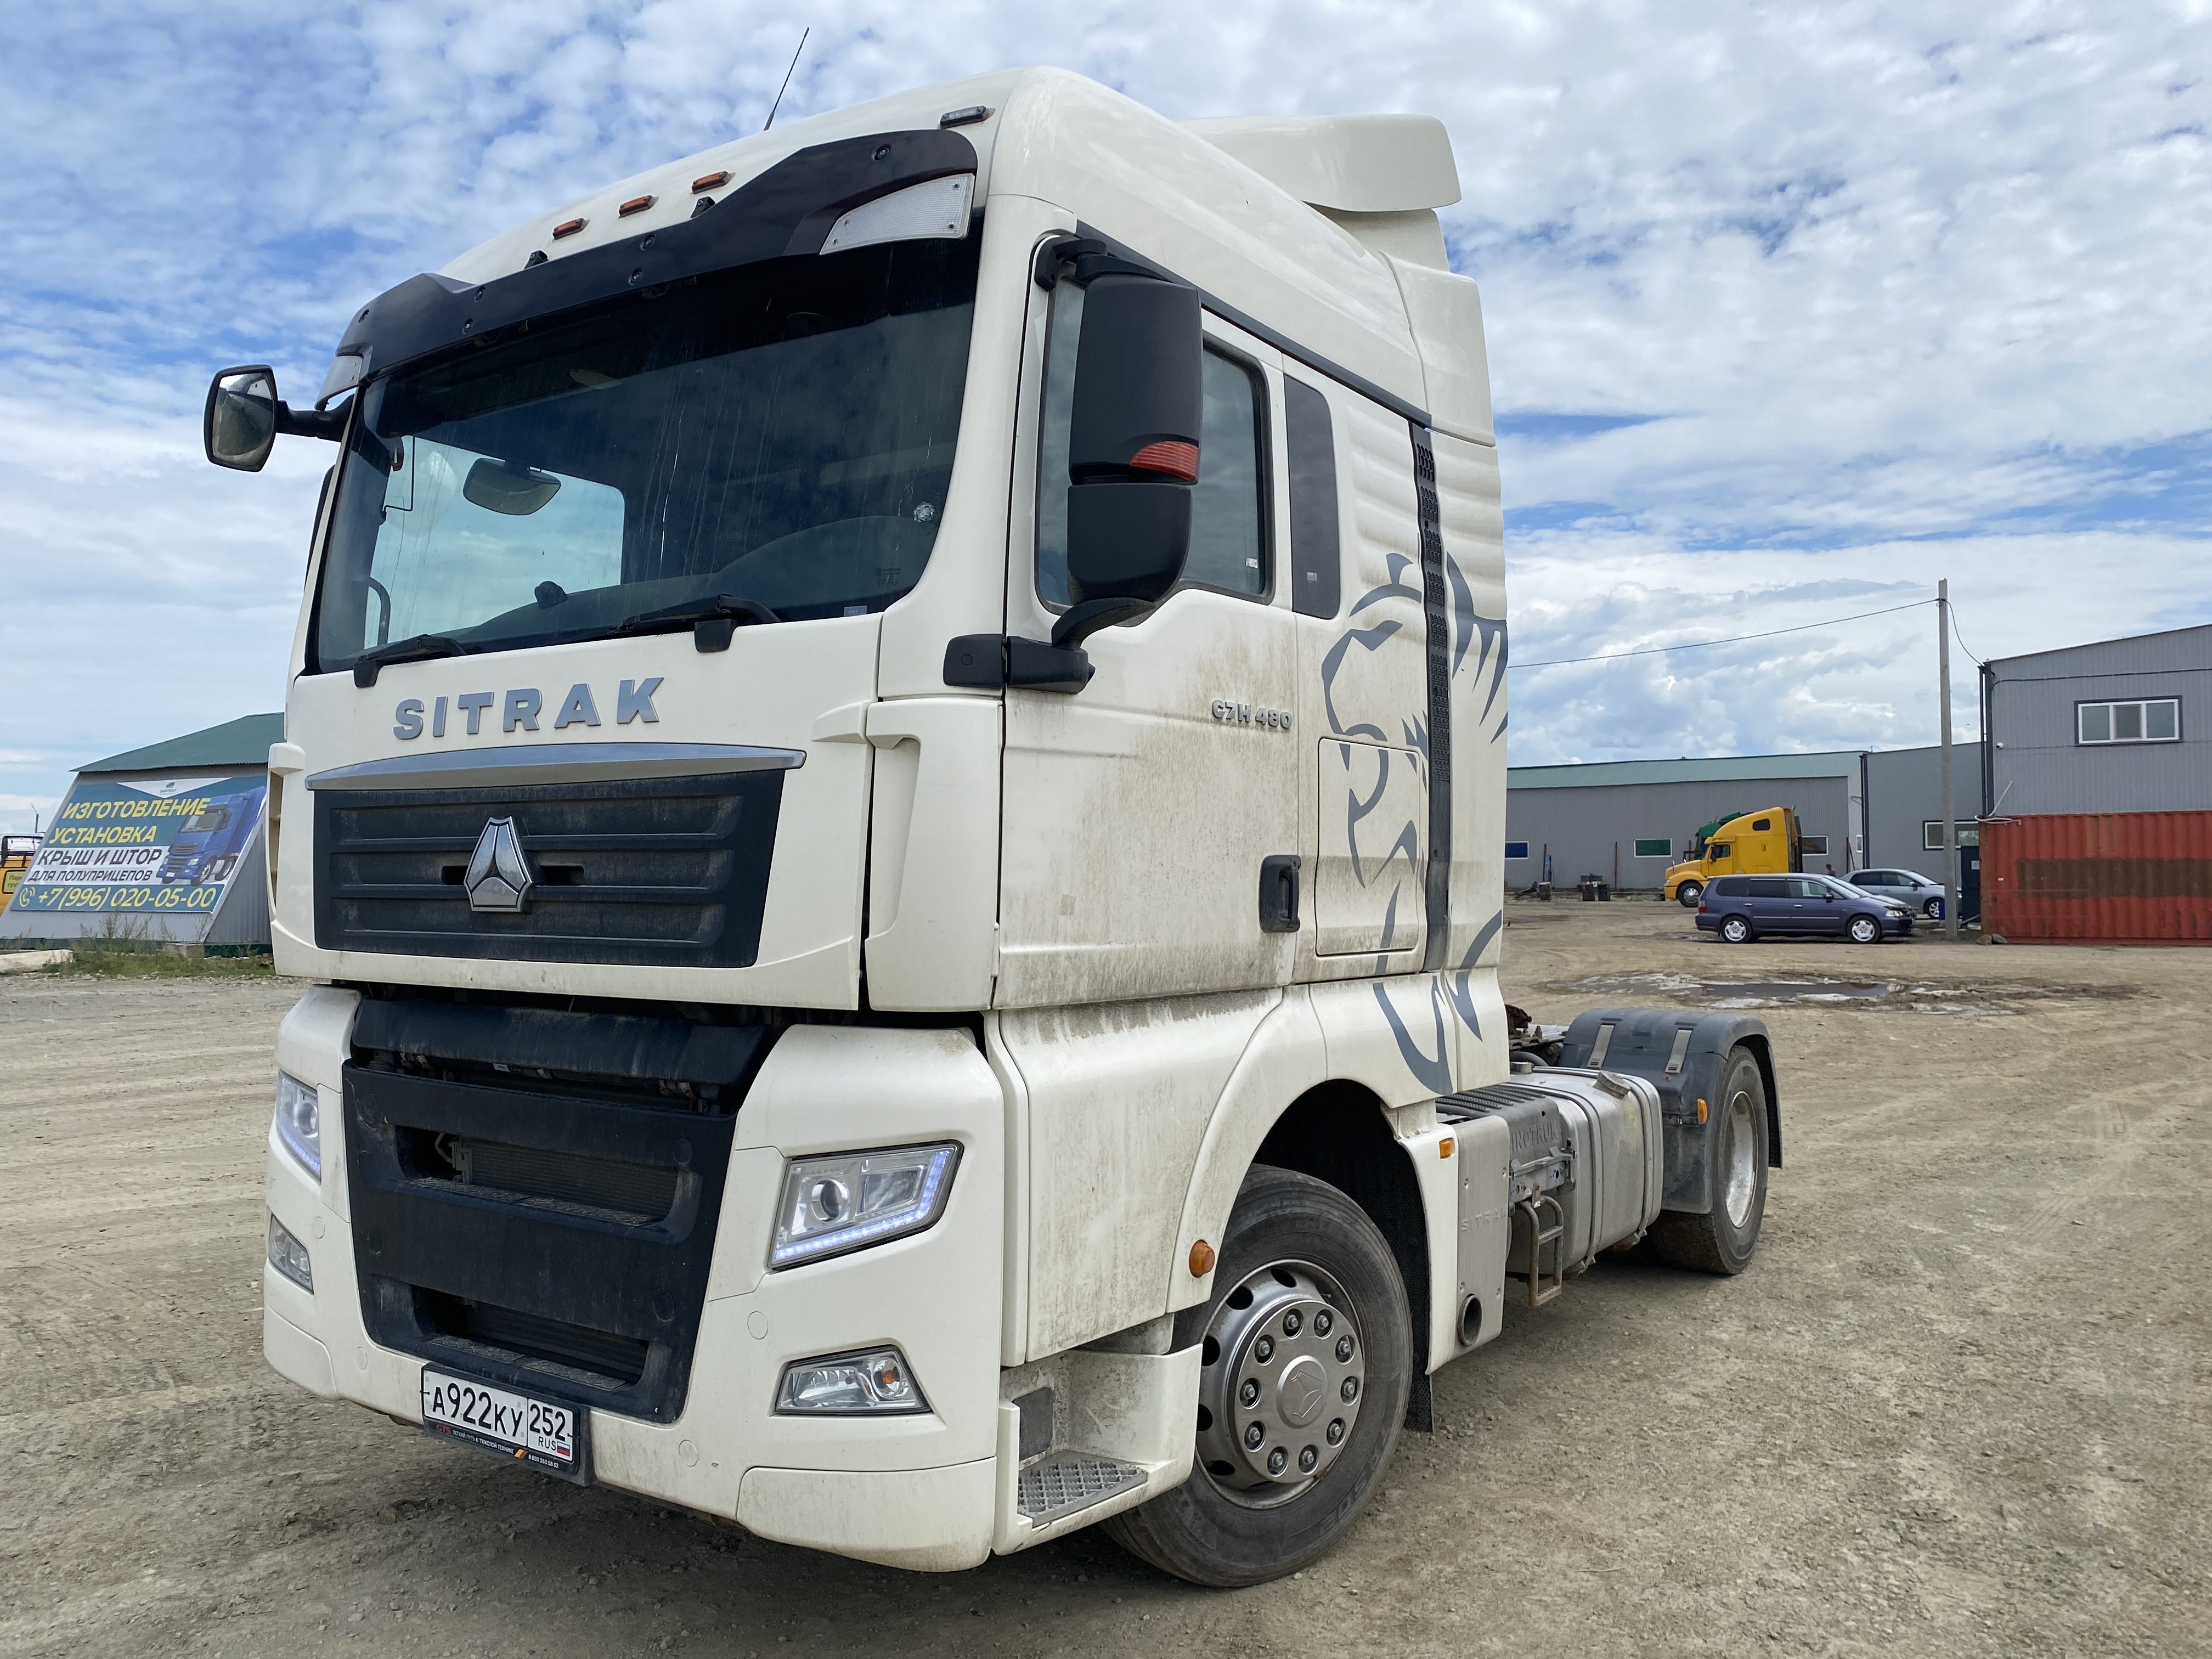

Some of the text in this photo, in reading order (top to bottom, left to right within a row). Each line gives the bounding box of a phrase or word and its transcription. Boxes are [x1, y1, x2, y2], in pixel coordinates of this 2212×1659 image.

[393, 677, 664, 740] SITRAK
[1211, 699, 1292, 729] C7H 480
[62, 797, 211, 819] ИЗГОТОВЛЕНИЕ
[49, 825, 157, 844] УСТАНОВКА
[37, 849, 163, 865] КРЫШ И ШТОР
[27, 870, 153, 882] ДЛЯ ПОЛУПРИЦЕПОВ
[110, 887, 217, 908] 020-05-00
[436, 1424, 452, 1435] GTS
[529, 1403, 566, 1441] 252
[538, 1436, 556, 1451] RUS
